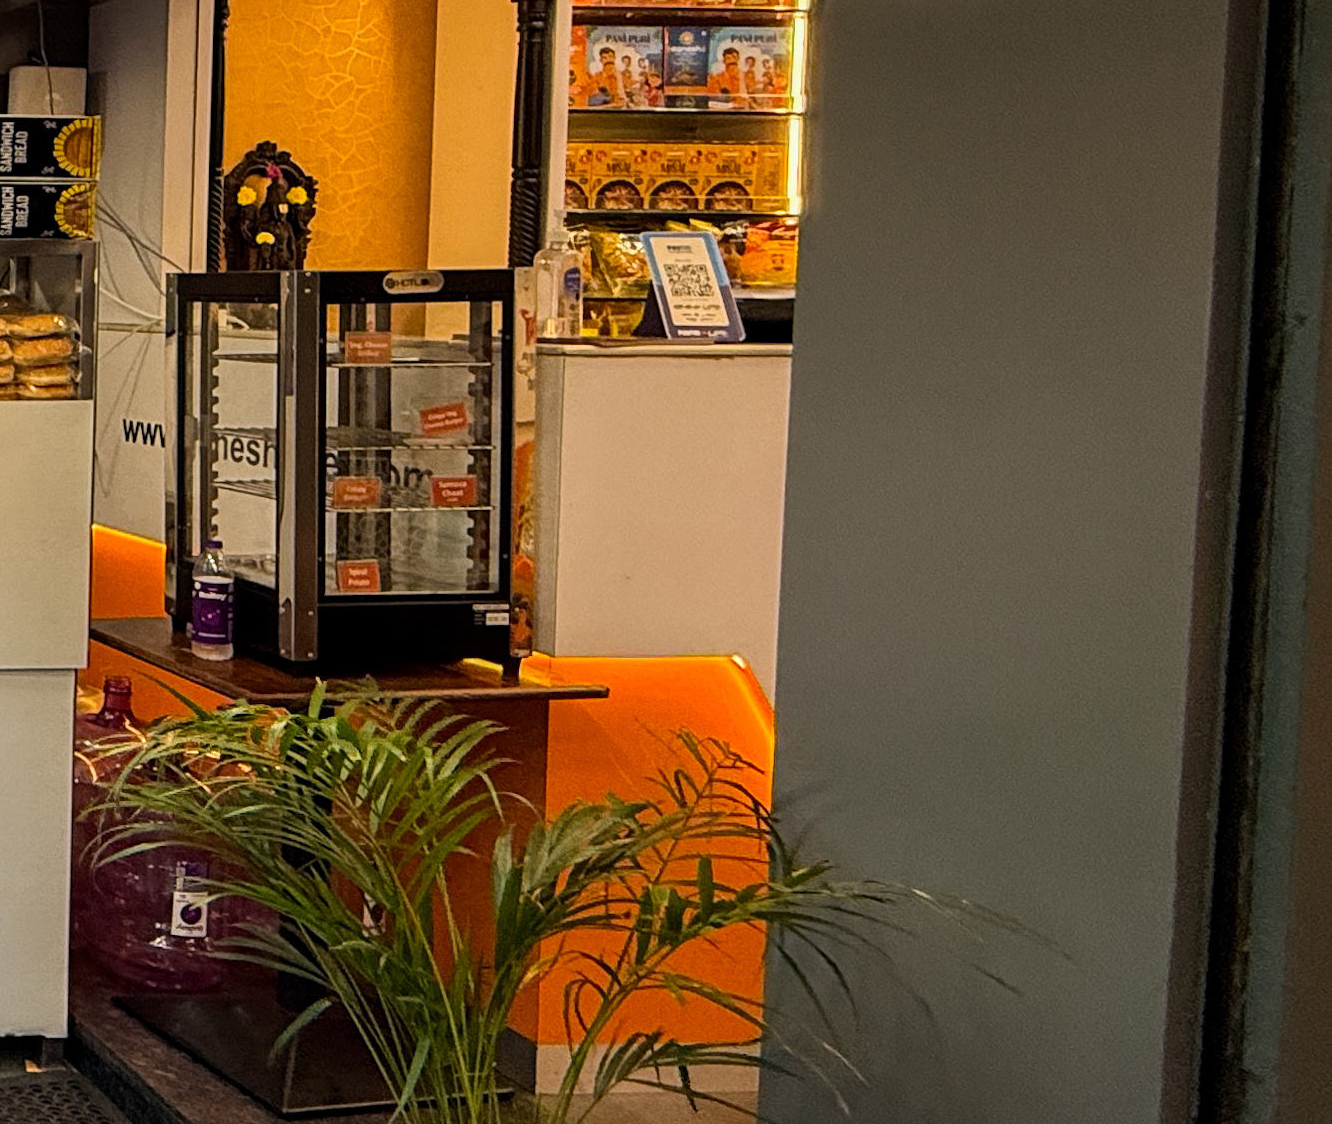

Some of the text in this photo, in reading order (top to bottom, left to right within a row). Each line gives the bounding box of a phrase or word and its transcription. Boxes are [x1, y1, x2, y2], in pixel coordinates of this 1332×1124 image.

[0, 121, 15, 173] SANDWICH
[14, 131, 29, 164] BREAD
[0, 186, 16, 236] SANDWICH
[15, 195, 30, 228] BREAD
